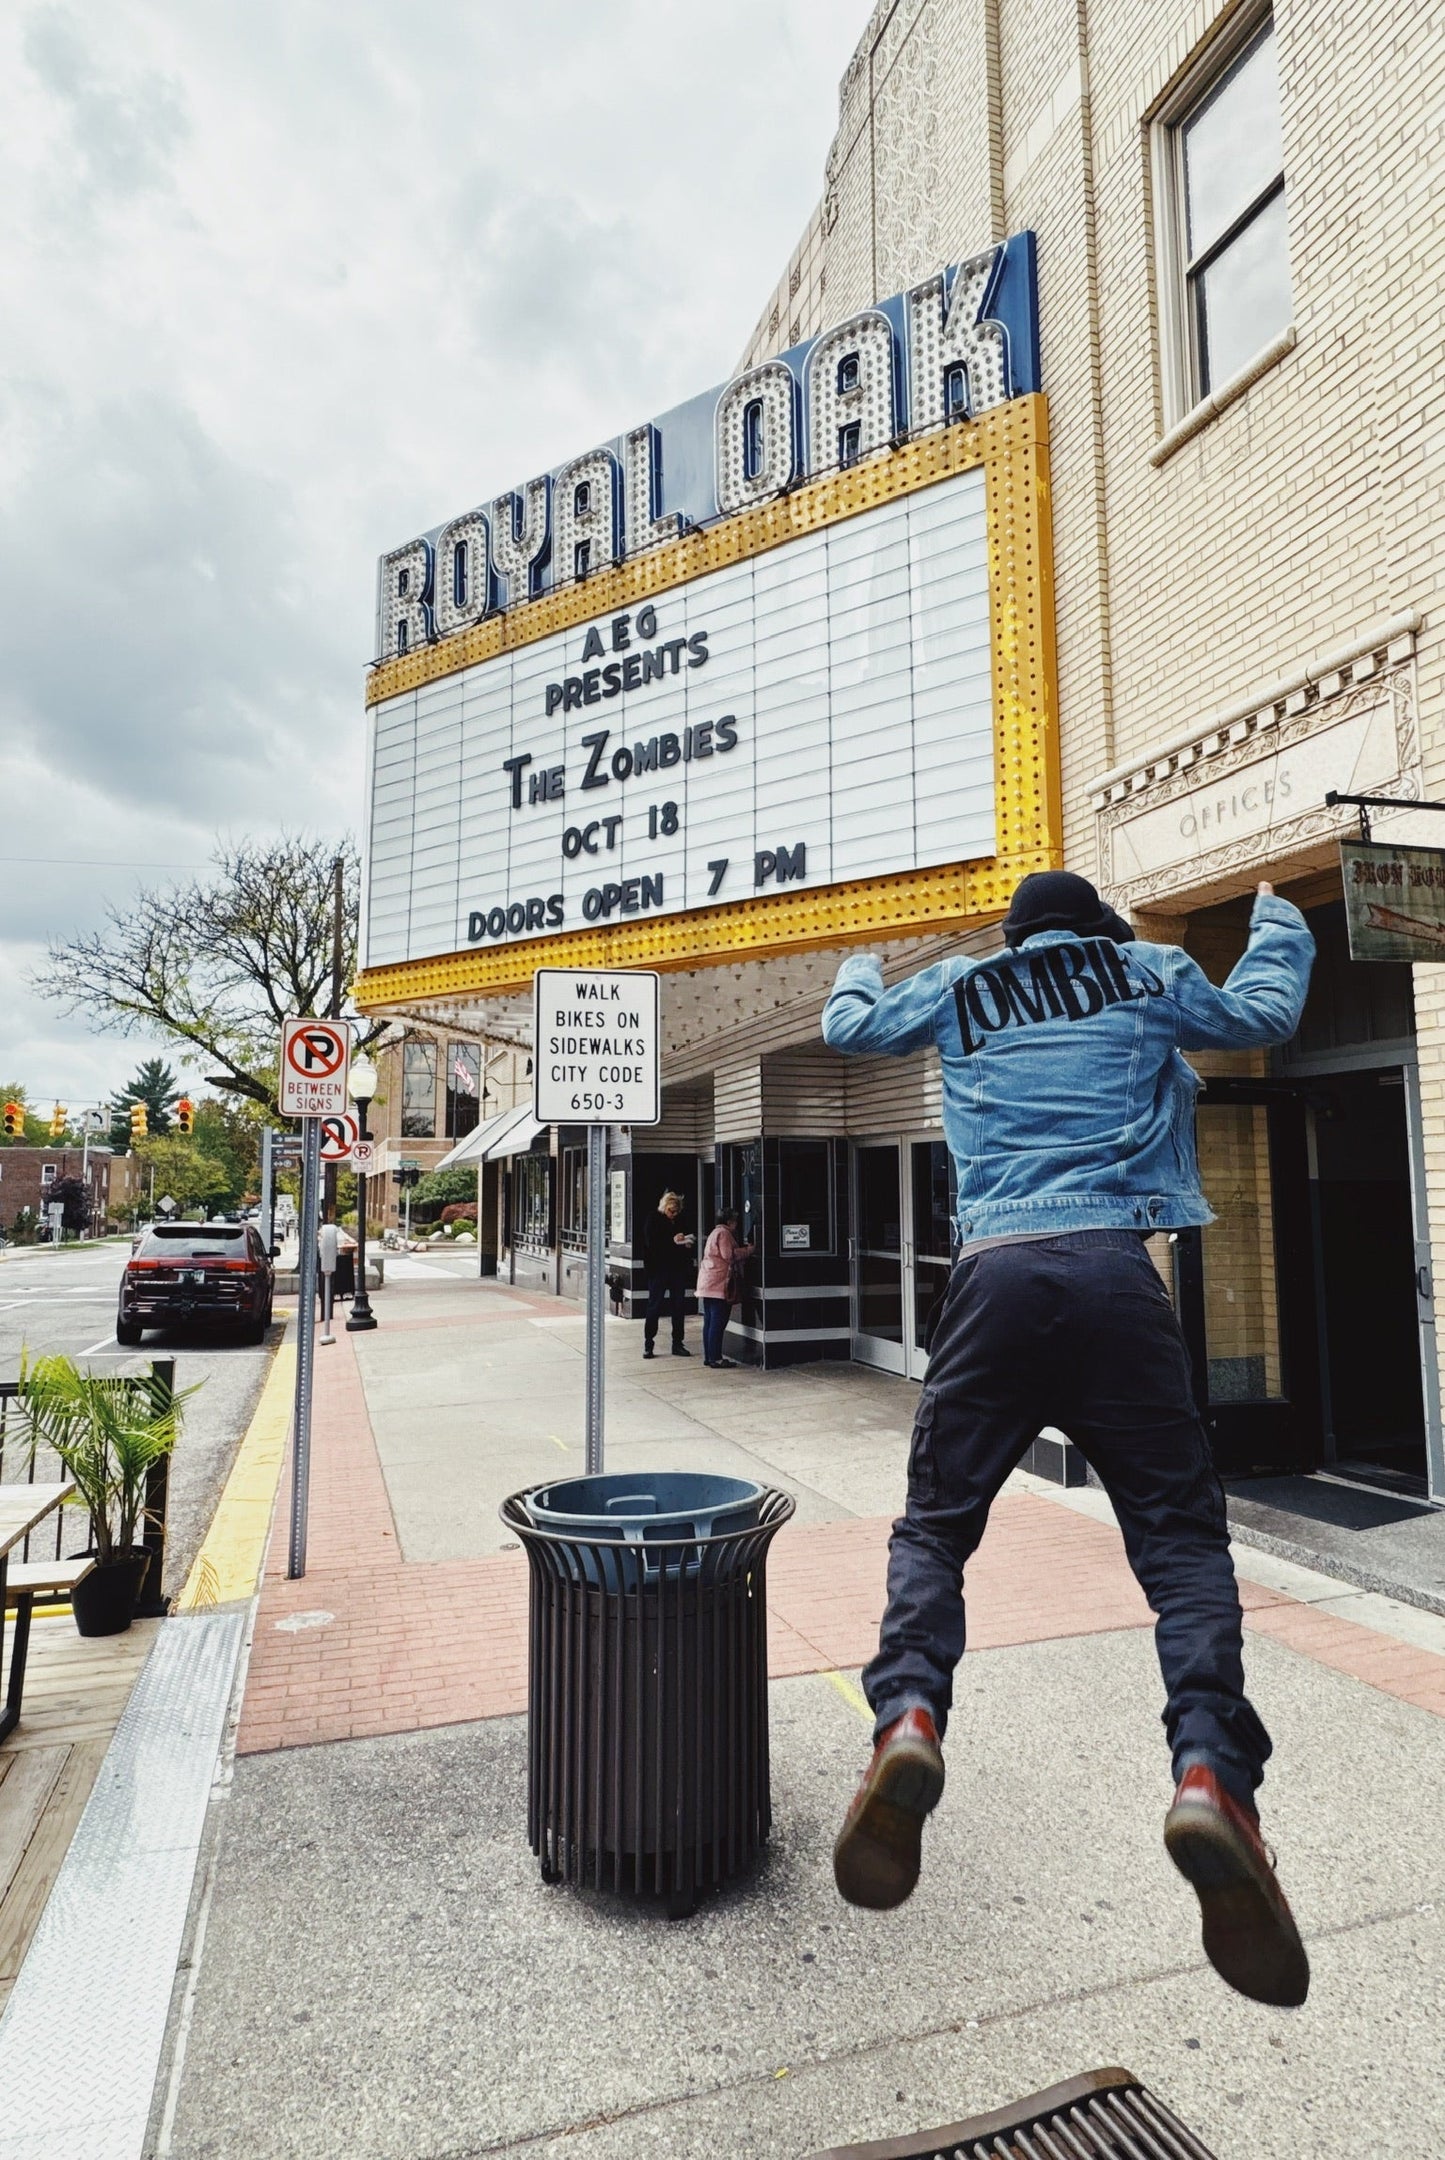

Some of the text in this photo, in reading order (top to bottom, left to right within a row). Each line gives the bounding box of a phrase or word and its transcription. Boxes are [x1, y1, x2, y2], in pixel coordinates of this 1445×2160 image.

[380, 243, 1013, 658] ROYAL OAK
[545, 631, 709, 716] PRESENTS
[1180, 771, 1292, 837] OFFICES
[562, 801, 679, 859] OCT 18
[467, 842, 806, 942] DOORS OPEN 7 PM
[576, 983, 620, 1000] WALK
[556, 1011, 639, 1028] BIKES ON
[550, 1037, 645, 1056] SIDEWALKS
[551, 1065, 643, 1083] CITY CODE
[288, 1082, 342, 1095] BETWEEN
[296, 1098, 332, 1111] SIGNS
[571, 1093, 624, 1110] 650-3
[279, 1203, 292, 1211] 25
